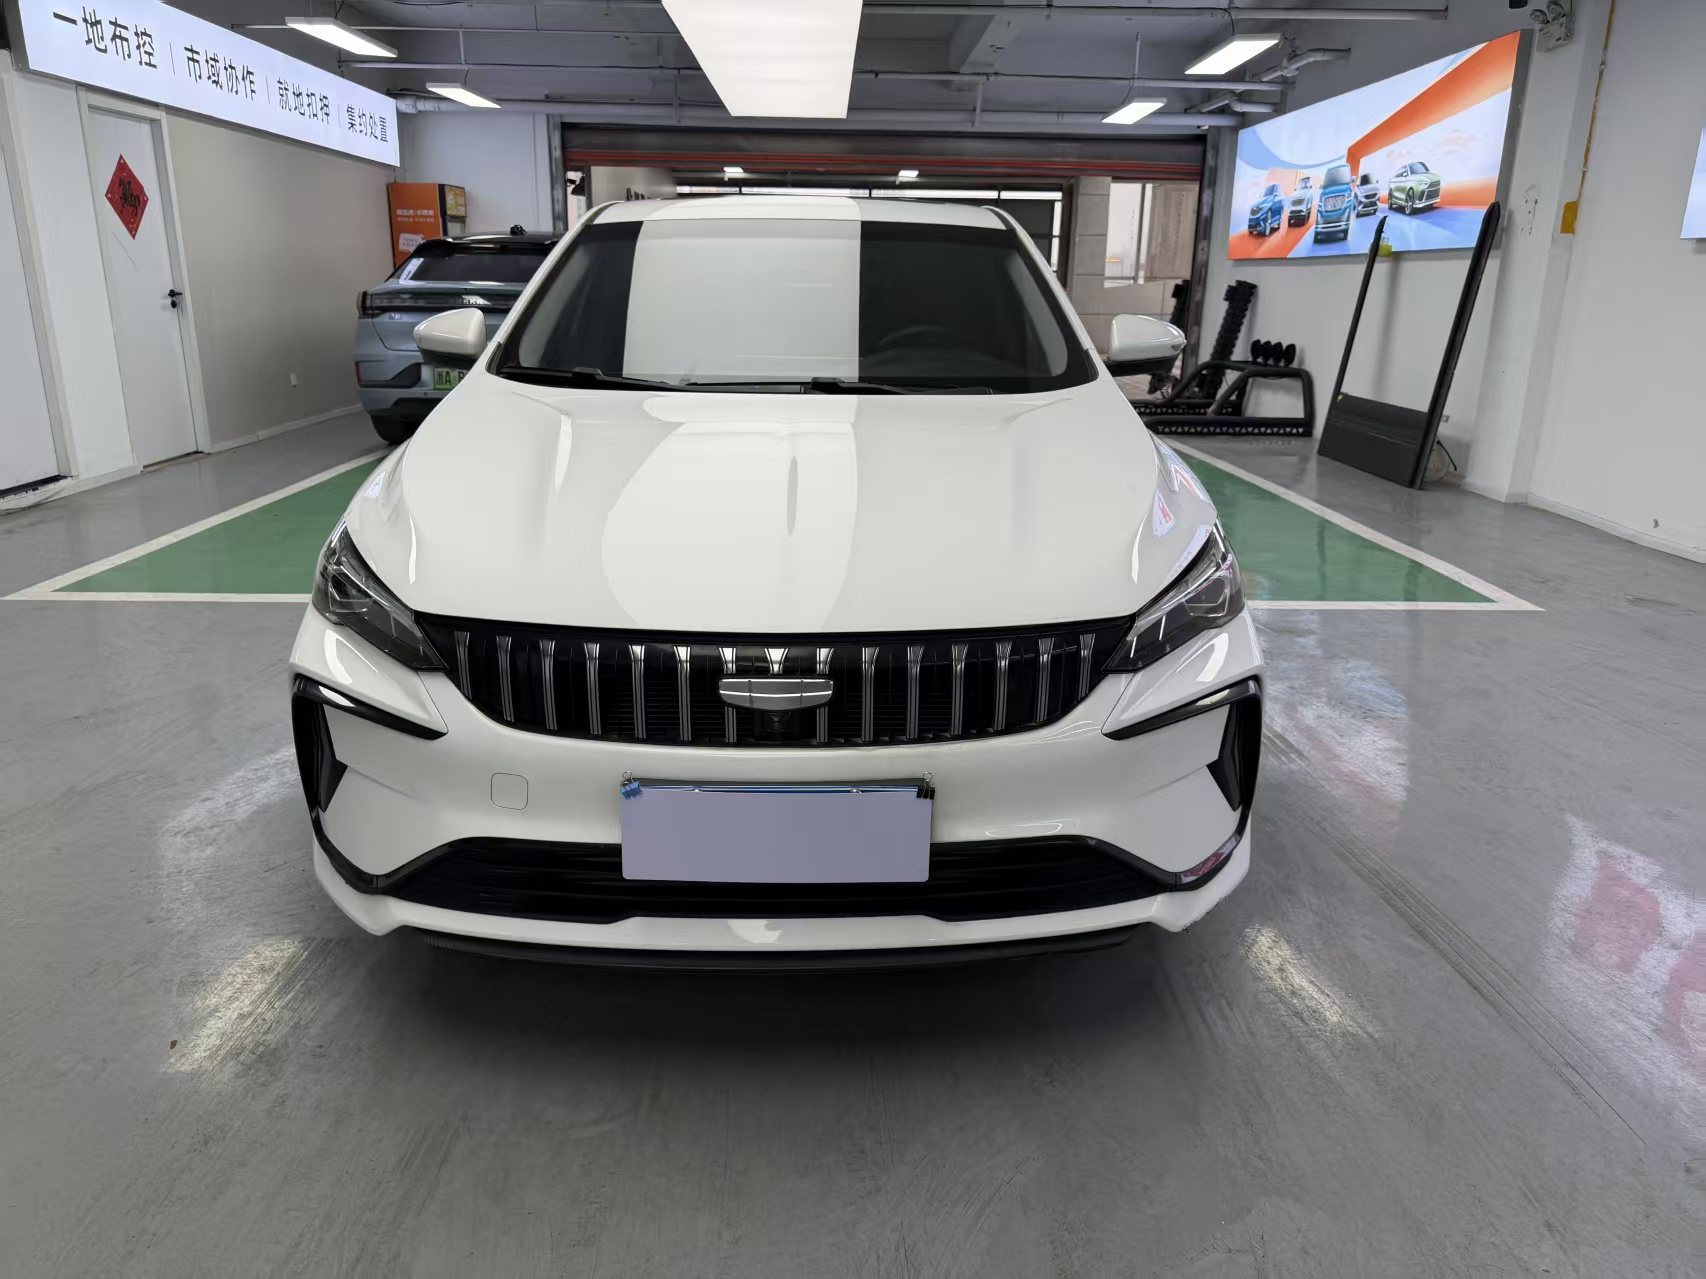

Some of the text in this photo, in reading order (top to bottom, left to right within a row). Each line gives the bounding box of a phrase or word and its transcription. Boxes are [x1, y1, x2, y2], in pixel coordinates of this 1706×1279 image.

[53, 6, 157, 69] 一地布控
[184, 45, 256, 100] 市域协作
[277, 78, 329, 124] 就地扣押
